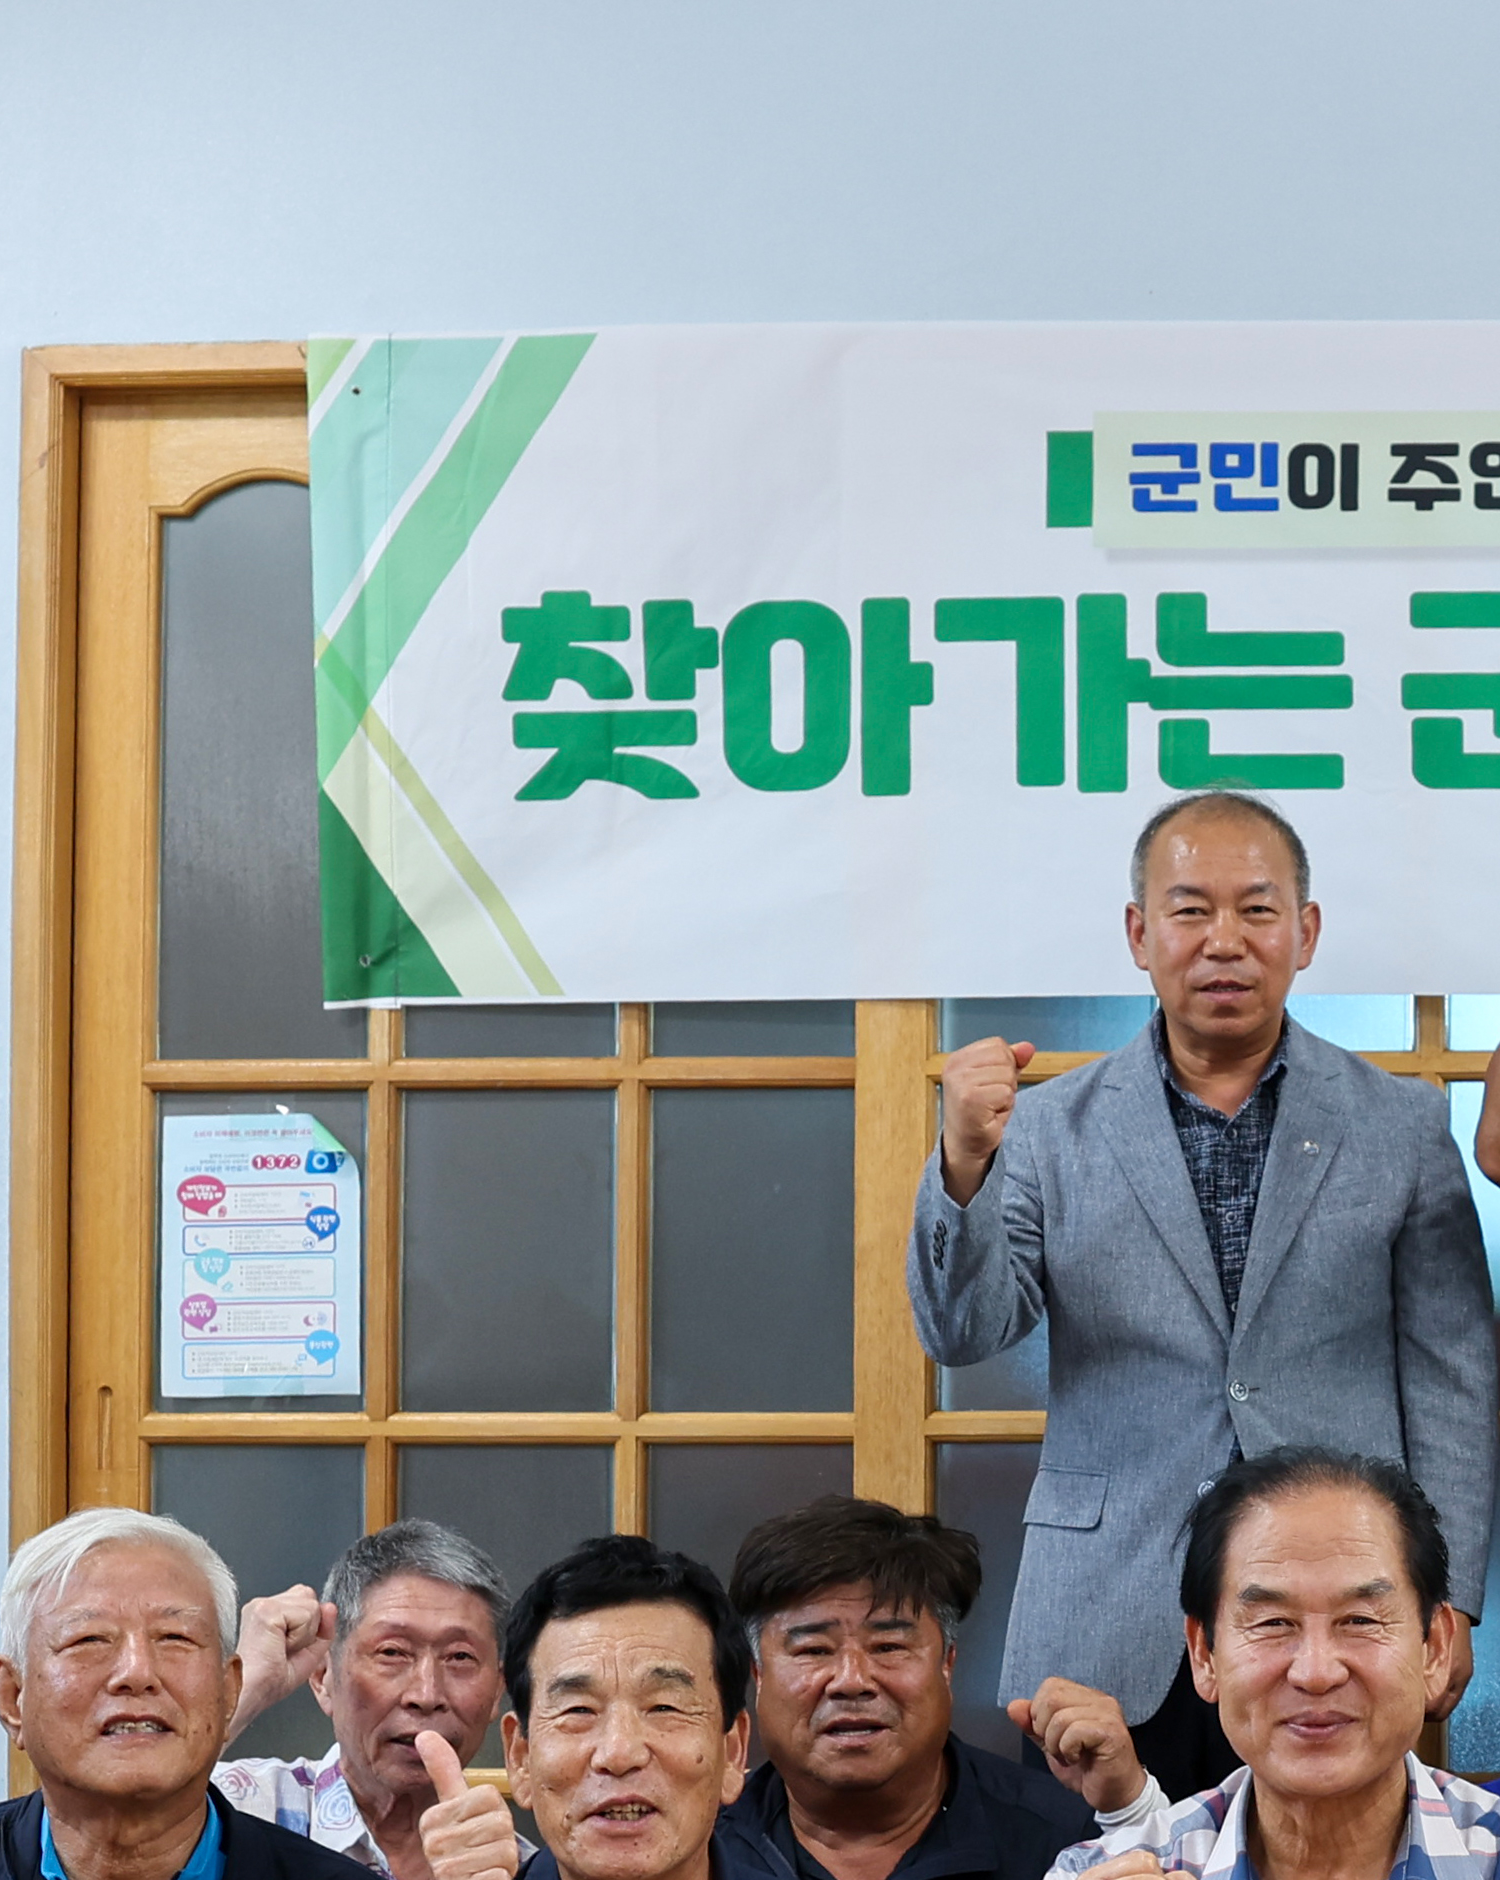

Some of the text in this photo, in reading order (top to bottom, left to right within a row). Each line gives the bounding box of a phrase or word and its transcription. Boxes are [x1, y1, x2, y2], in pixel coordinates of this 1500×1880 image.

[1128, 441, 1360, 513] 군민이
[502, 590, 1353, 800] 찾아가는
[254, 1155, 299, 1169] 1372
